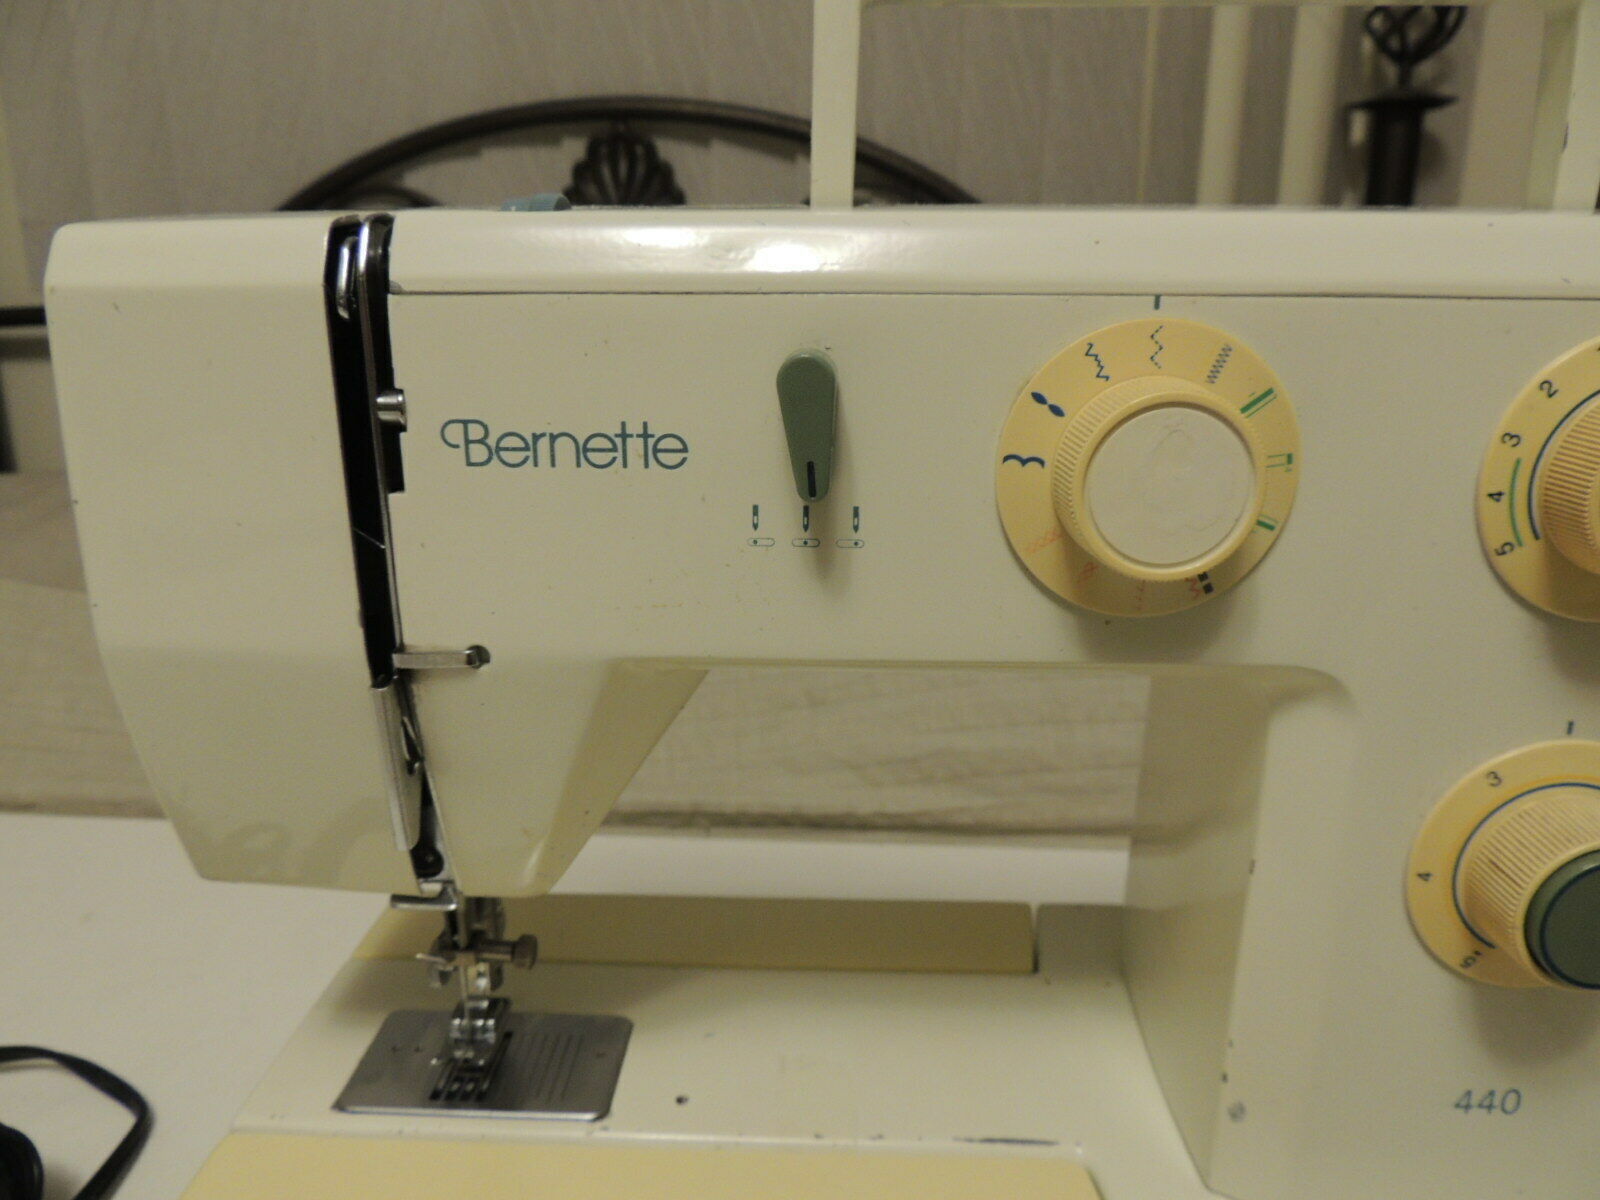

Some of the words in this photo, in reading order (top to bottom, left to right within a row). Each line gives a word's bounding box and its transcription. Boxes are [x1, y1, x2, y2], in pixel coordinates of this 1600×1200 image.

[1539, 380, 1558, 398] 2
[440, 418, 689, 470] Bernette
[1501, 432, 1521, 448] 3
[1487, 490, 1505, 502] 4
[1494, 541, 1515, 556] 5
[1485, 770, 1502, 787] 3
[1417, 871, 1433, 882] 4
[1454, 1088, 1521, 1116] 440
